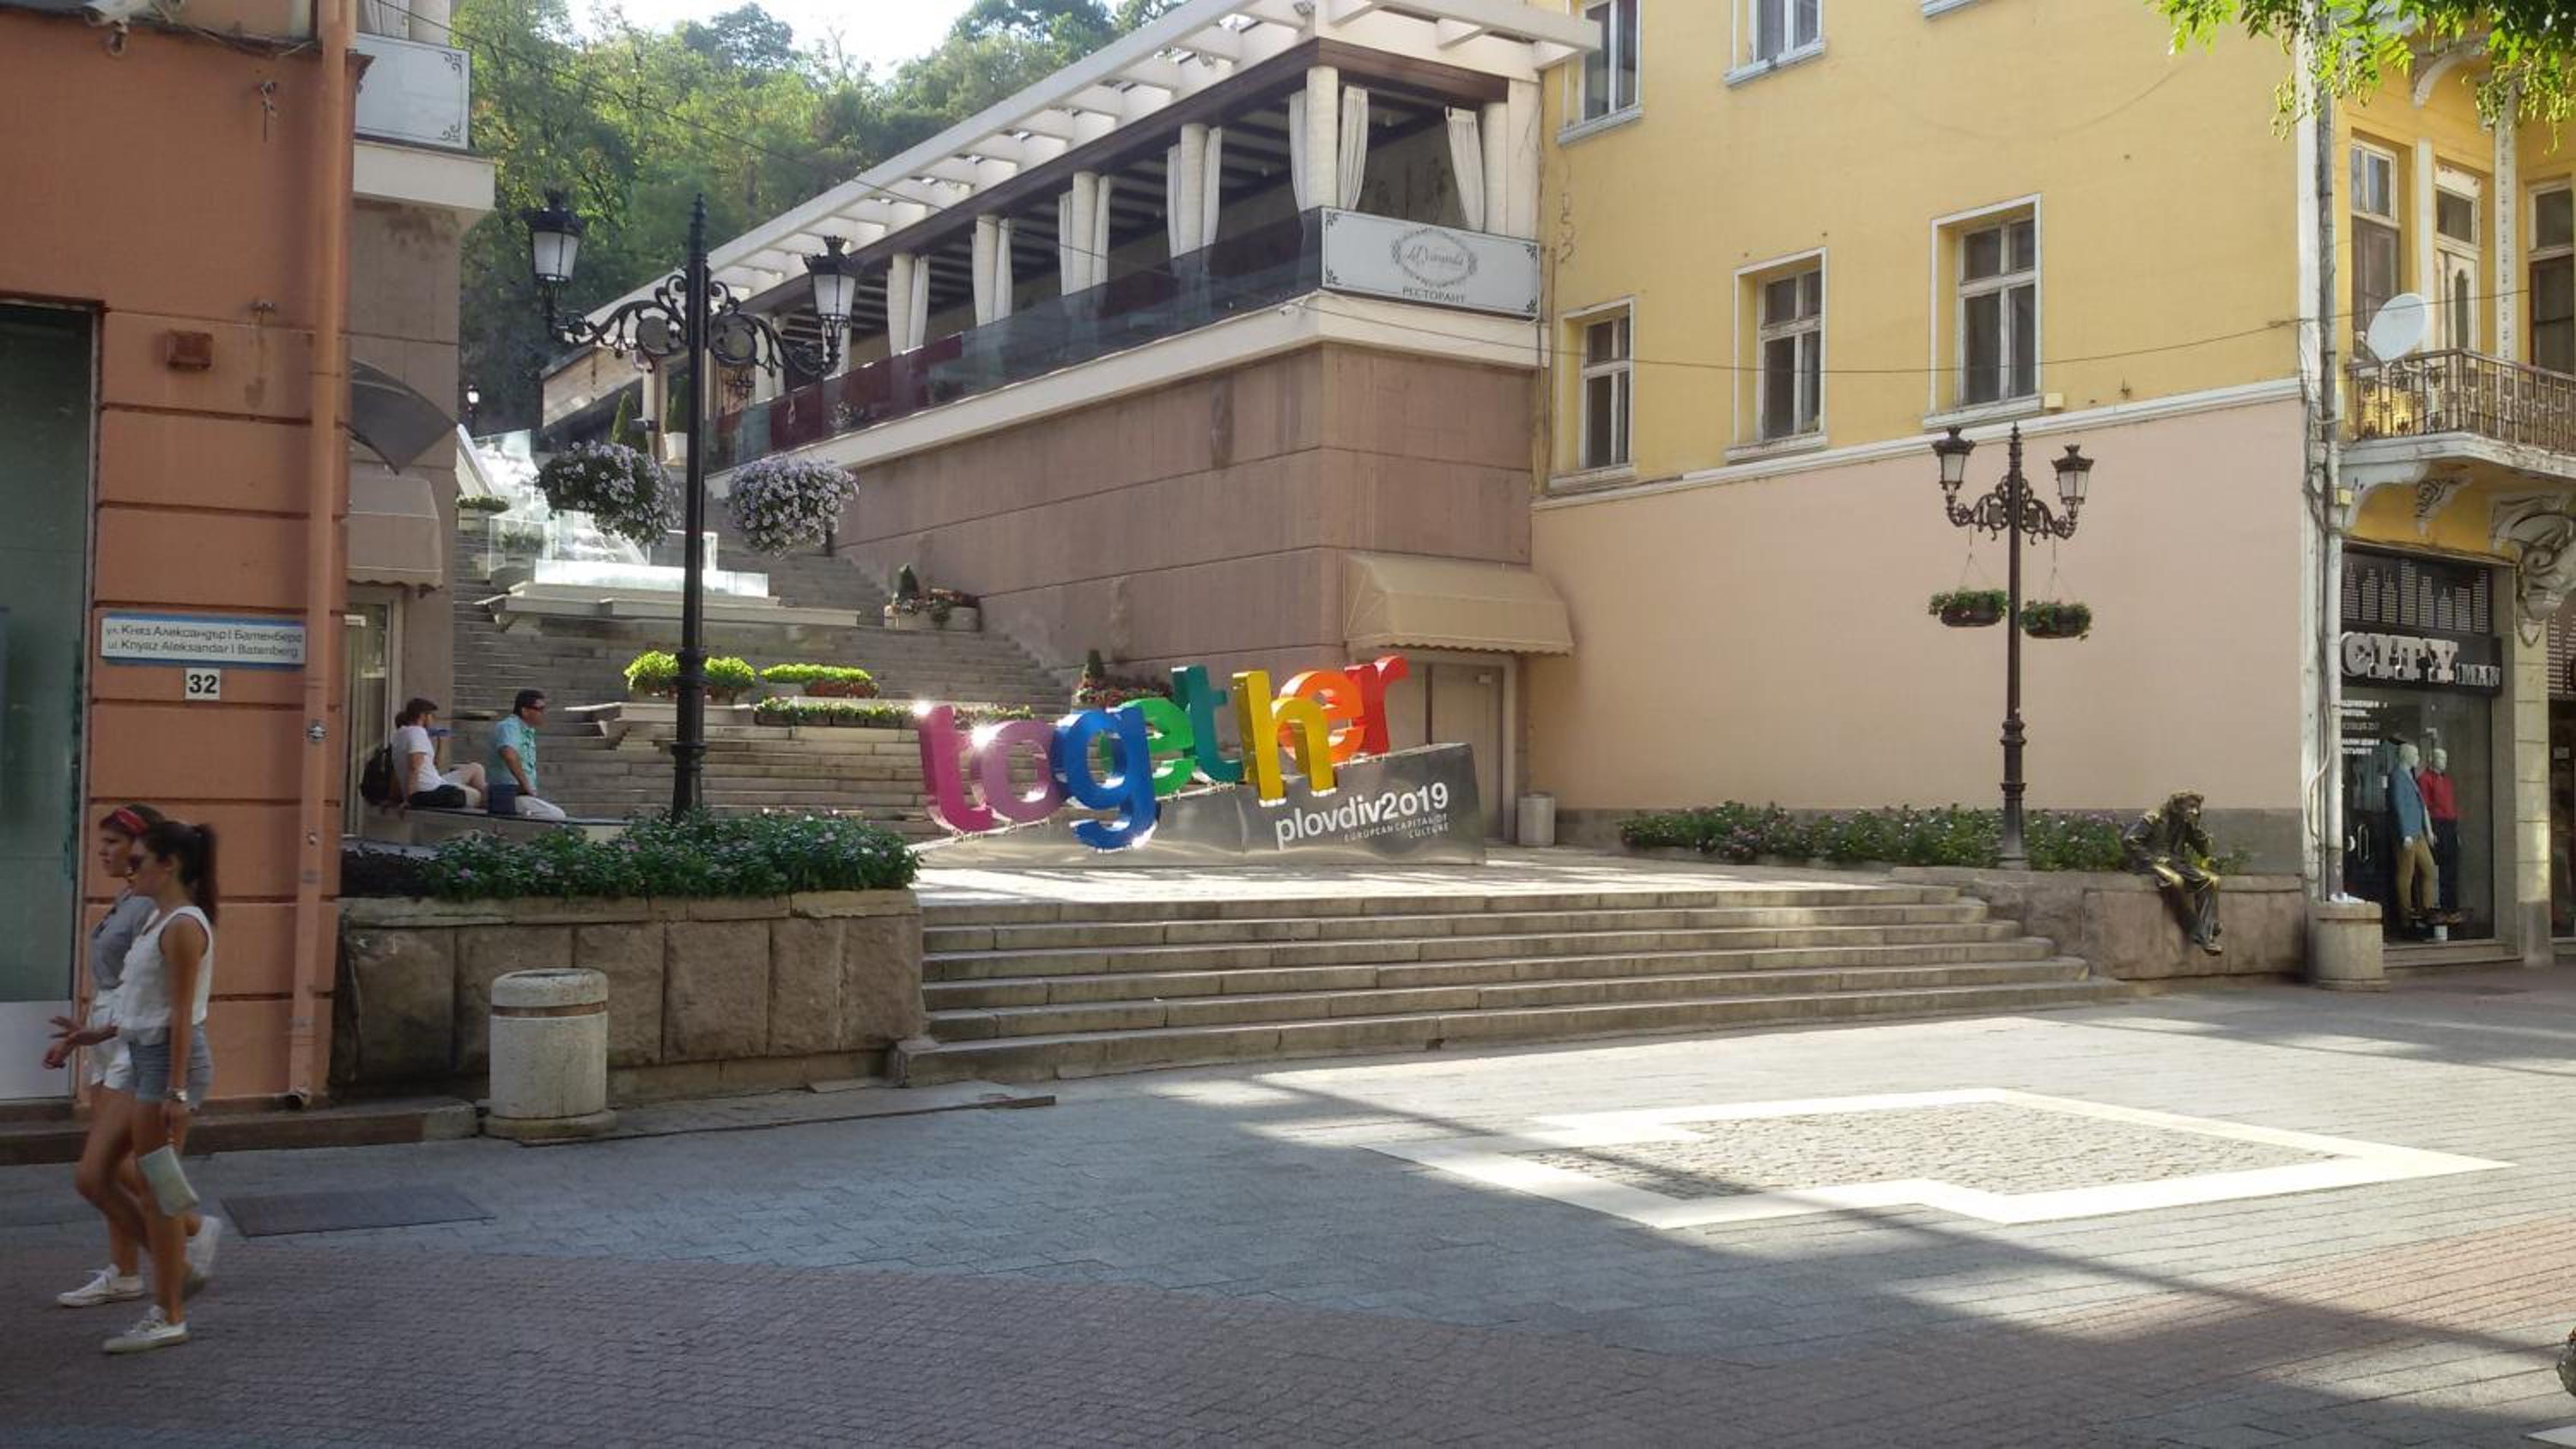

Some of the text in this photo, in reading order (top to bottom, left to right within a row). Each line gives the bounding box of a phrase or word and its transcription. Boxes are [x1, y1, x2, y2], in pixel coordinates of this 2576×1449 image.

[1401, 286, 1464, 303] РЕСТОРАНТ
[121, 639, 159, 652] Knyaz
[2341, 631, 2459, 684] CITY
[188, 674, 218, 694] 32
[918, 655, 1409, 851] together
